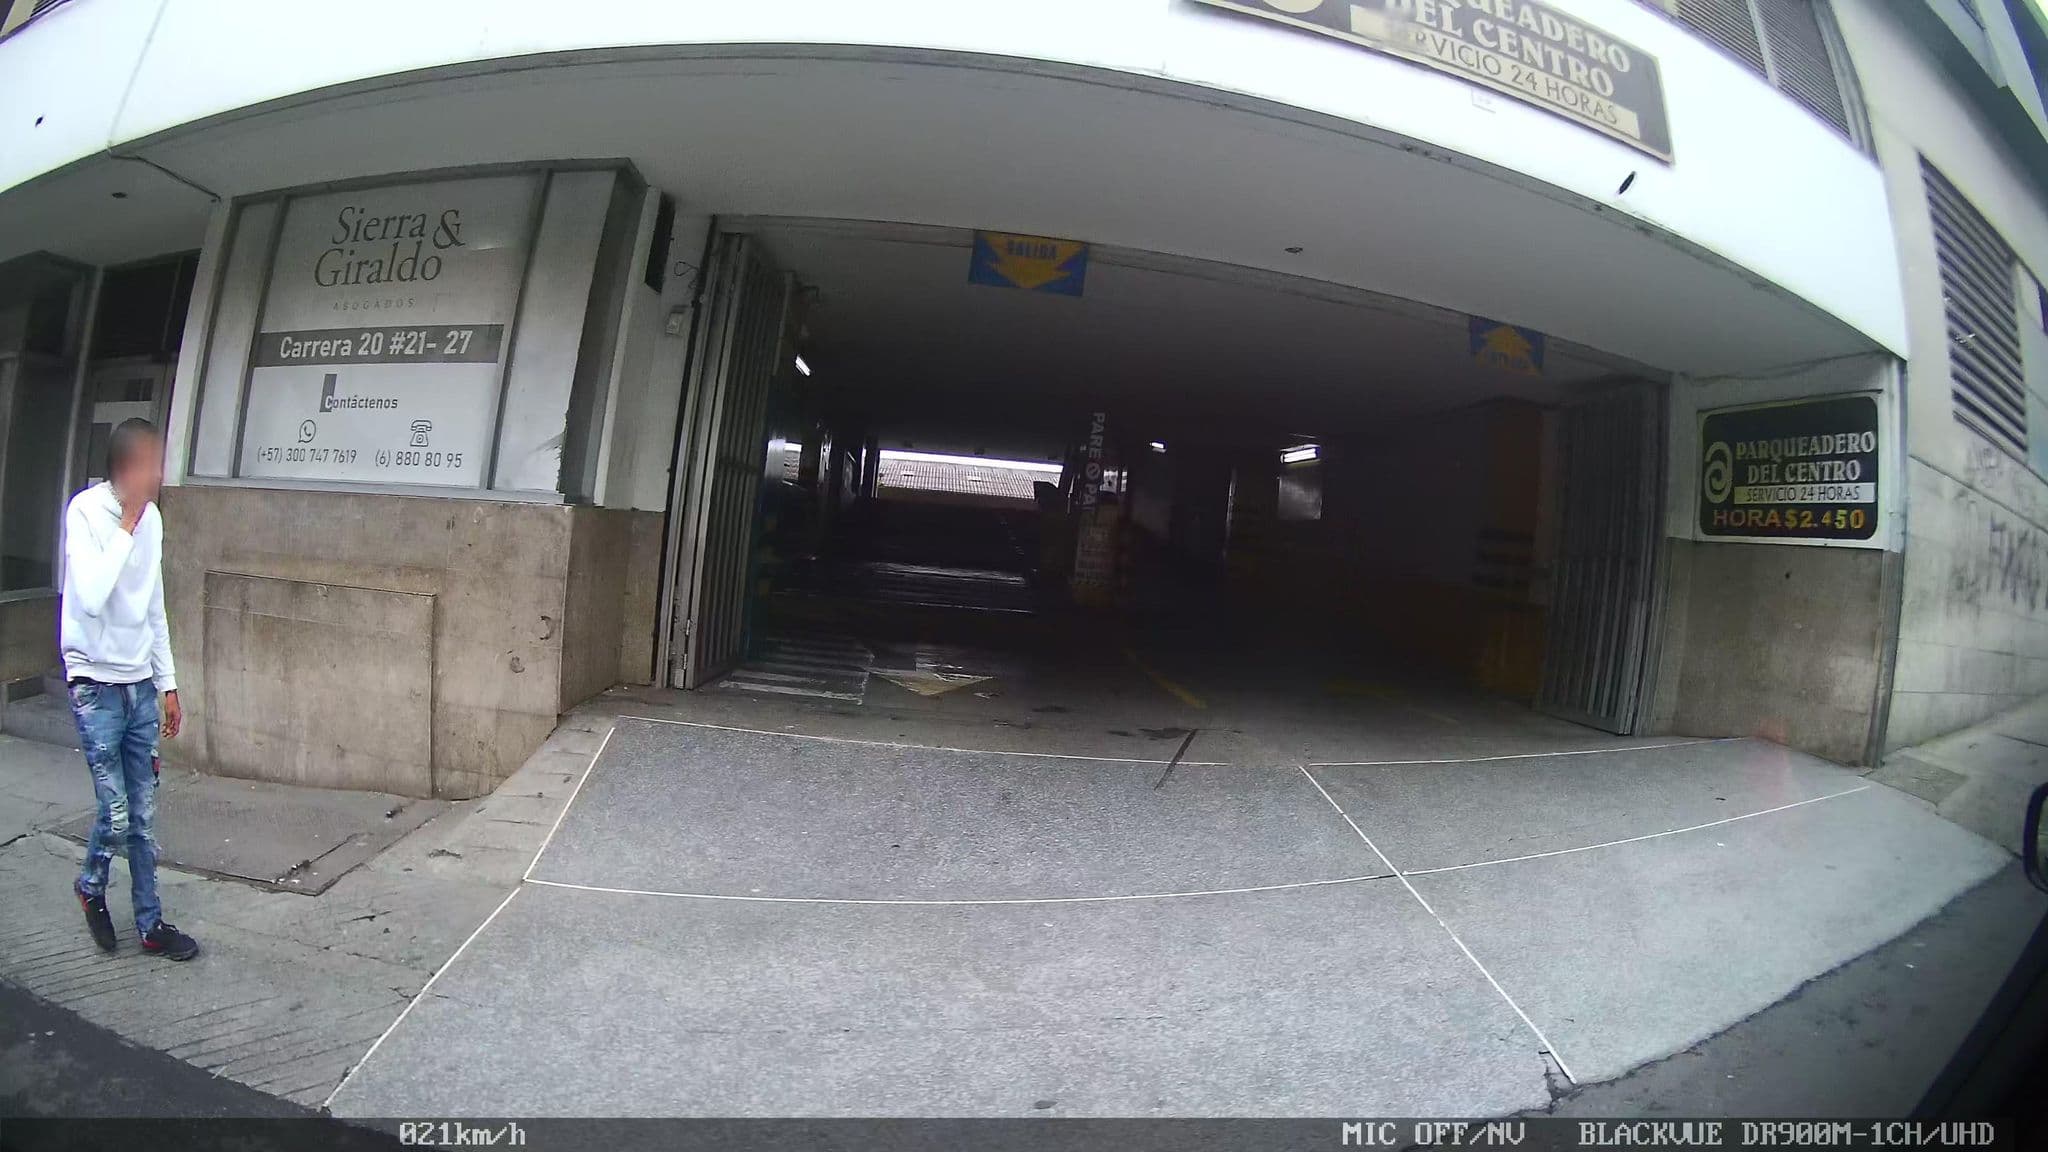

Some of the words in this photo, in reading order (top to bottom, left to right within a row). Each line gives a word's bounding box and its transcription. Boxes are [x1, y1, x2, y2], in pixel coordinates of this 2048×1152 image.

[1473, 18, 1614, 97] CENTRO
[1511, 64, 1537, 91] 24
[1546, 77, 1618, 125] HORAS
[332, 206, 427, 245] Sierra
[432, 209, 466, 249] &
[314, 239, 442, 287] Giraldo
[333, 298, 417, 311] ABOGADOS
[279, 336, 353, 359] Carrera
[358, 332, 384, 356] 20
[443, 329, 474, 355] 27
[324, 394, 399, 410] Contáctenos
[257, 447, 283, 464] (+57)
[286, 448, 306, 463] 300
[310, 448, 330, 464] 747
[333, 449, 357, 465] 7619
[375, 449, 391, 468] (6)
[396, 451, 420, 467] 880
[425, 452, 442, 468] 80
[447, 453, 463, 468] 95
[1736, 431, 1877, 462] PARQUEADERO
[1747, 464, 1781, 484] DEL
[1784, 459, 1861, 483] CENTRO
[1745, 485, 1797, 502] SERVICIO
[1800, 486, 1814, 501] 24
[1818, 485, 1860, 501] HORAS
[1713, 509, 1782, 527] HORA
